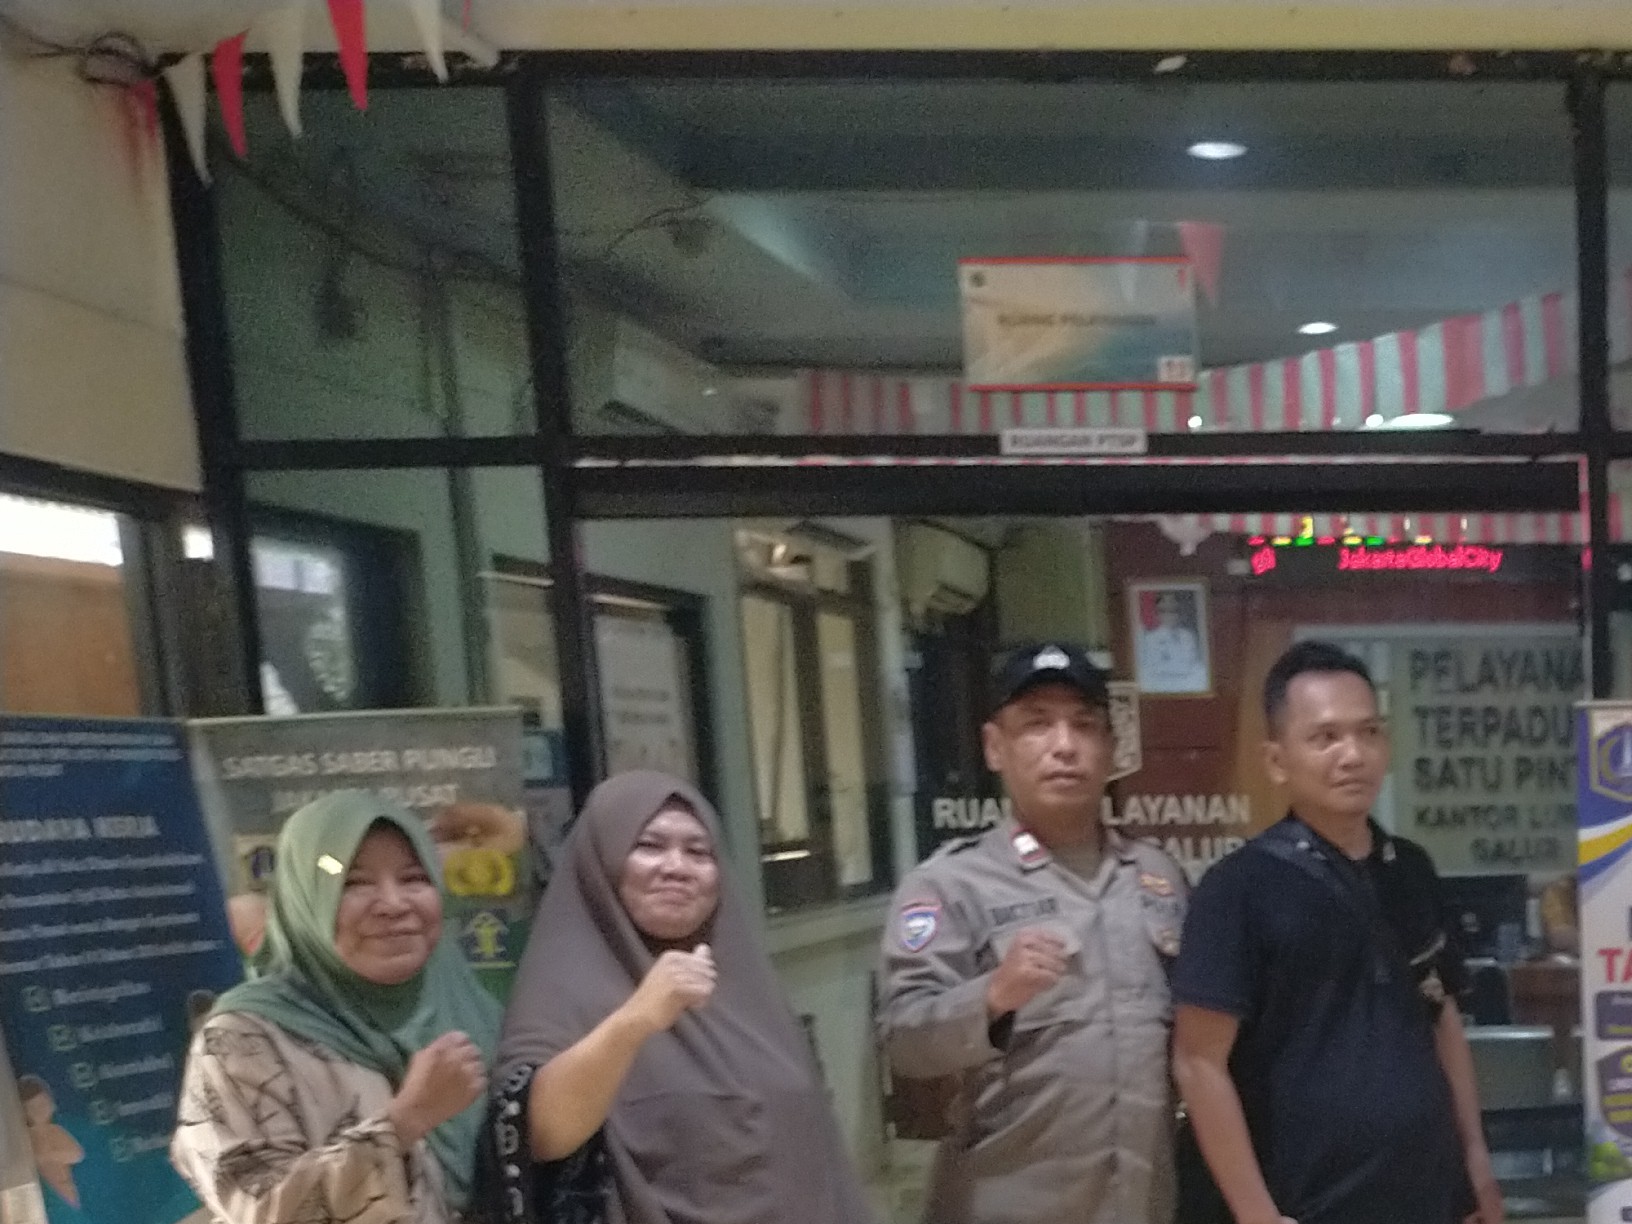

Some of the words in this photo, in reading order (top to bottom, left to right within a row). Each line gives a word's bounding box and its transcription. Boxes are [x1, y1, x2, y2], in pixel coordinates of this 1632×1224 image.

[1410, 649, 1585, 694] PELAYANA
[1414, 756, 1503, 793] SATU
[932, 797, 1012, 829] RUA
[1101, 794, 1250, 827] LAYANAN
